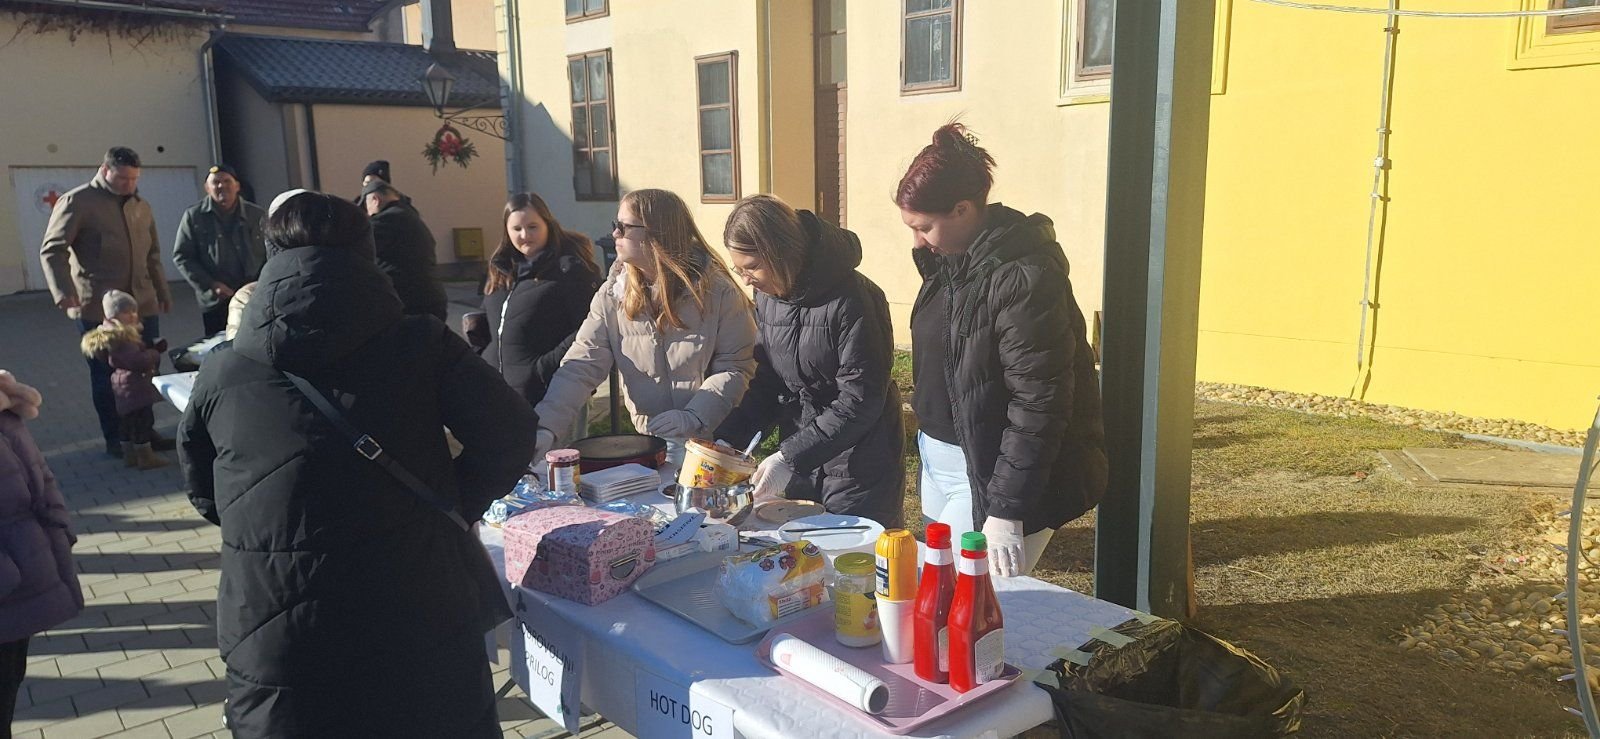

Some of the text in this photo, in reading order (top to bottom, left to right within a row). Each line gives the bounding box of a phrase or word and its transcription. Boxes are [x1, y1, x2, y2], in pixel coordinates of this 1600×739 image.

[525, 651, 554, 685] PRILOG
[650, 690, 713, 736] HOT DOG
